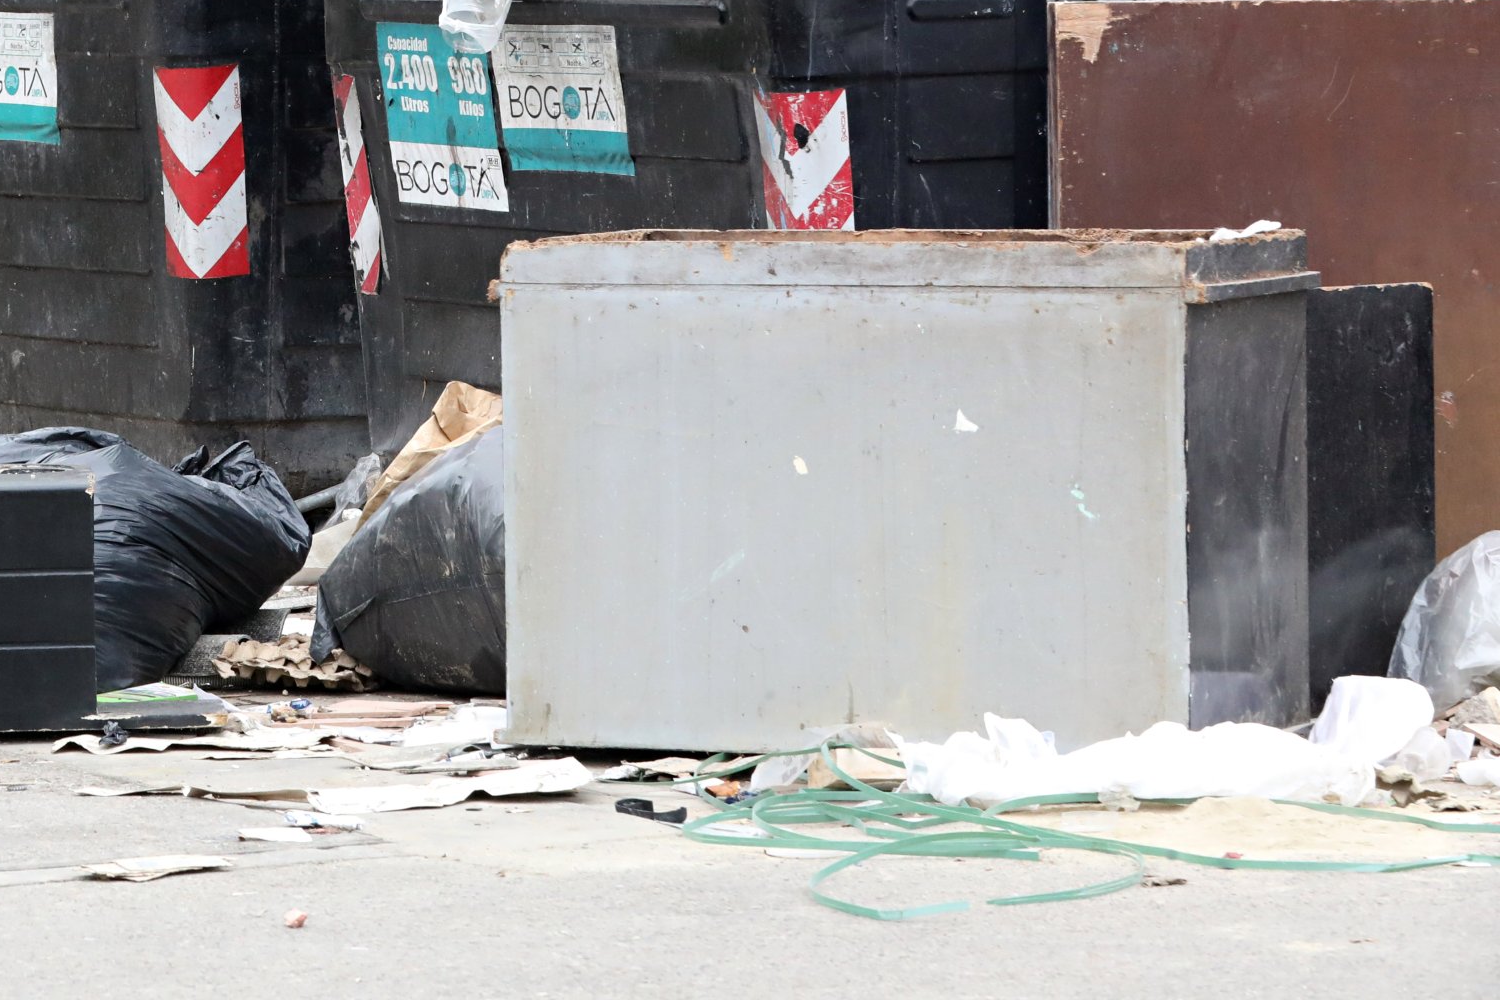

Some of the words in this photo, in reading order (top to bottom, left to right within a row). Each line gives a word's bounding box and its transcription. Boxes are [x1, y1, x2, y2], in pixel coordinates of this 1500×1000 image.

[387, 35, 428, 52] Capacidad
[384, 53, 438, 93] 2.400
[400, 95, 430, 114] Litros
[459, 99, 485, 117] Kilos
[507, 78, 616, 122] BOGOTÁ
[395, 158, 500, 201] BOGOTÁ
